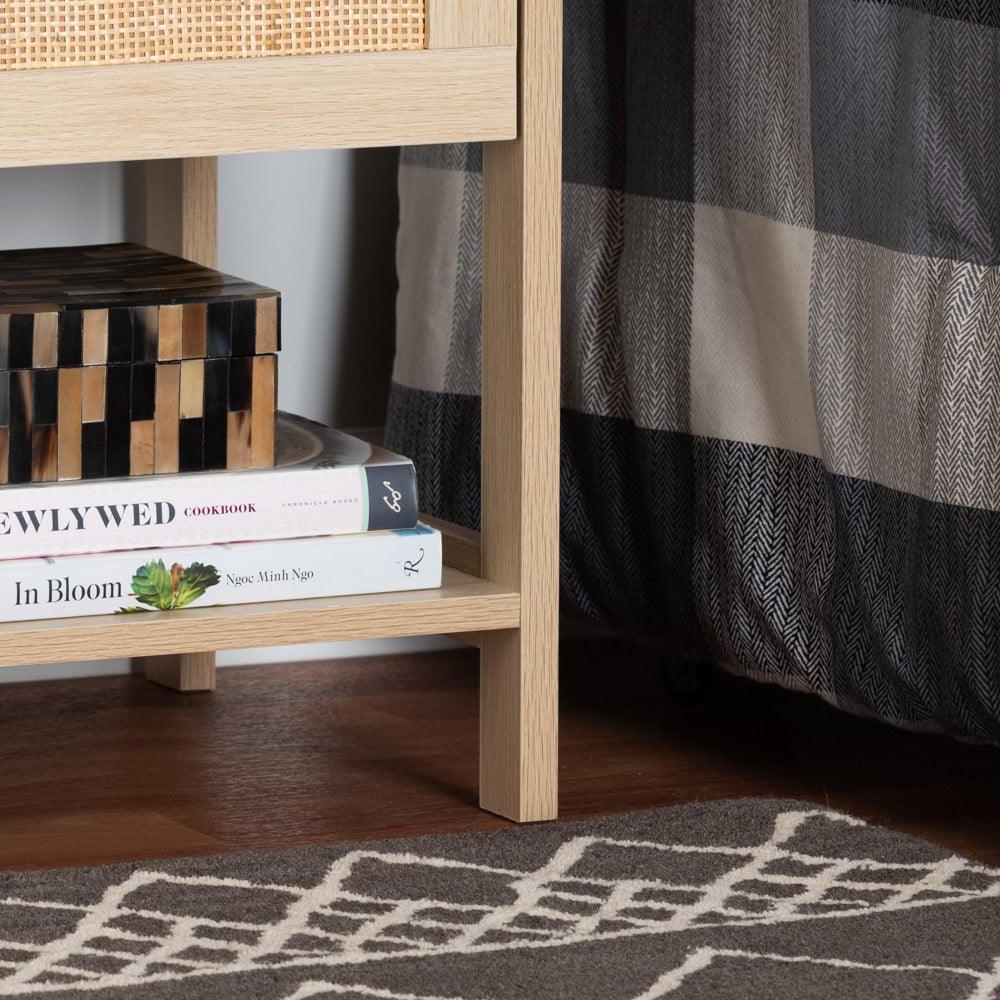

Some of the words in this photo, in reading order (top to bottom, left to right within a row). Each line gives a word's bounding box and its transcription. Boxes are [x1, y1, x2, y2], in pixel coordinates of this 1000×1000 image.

[184, 503, 257, 517] COOKBOOK
[226, 573, 254, 587] Ngoc
[257, 569, 289, 583] Minh
[292, 568, 314, 581] Ngo
[14, 581, 38, 606] In
[47, 576, 122, 603] Bloom
